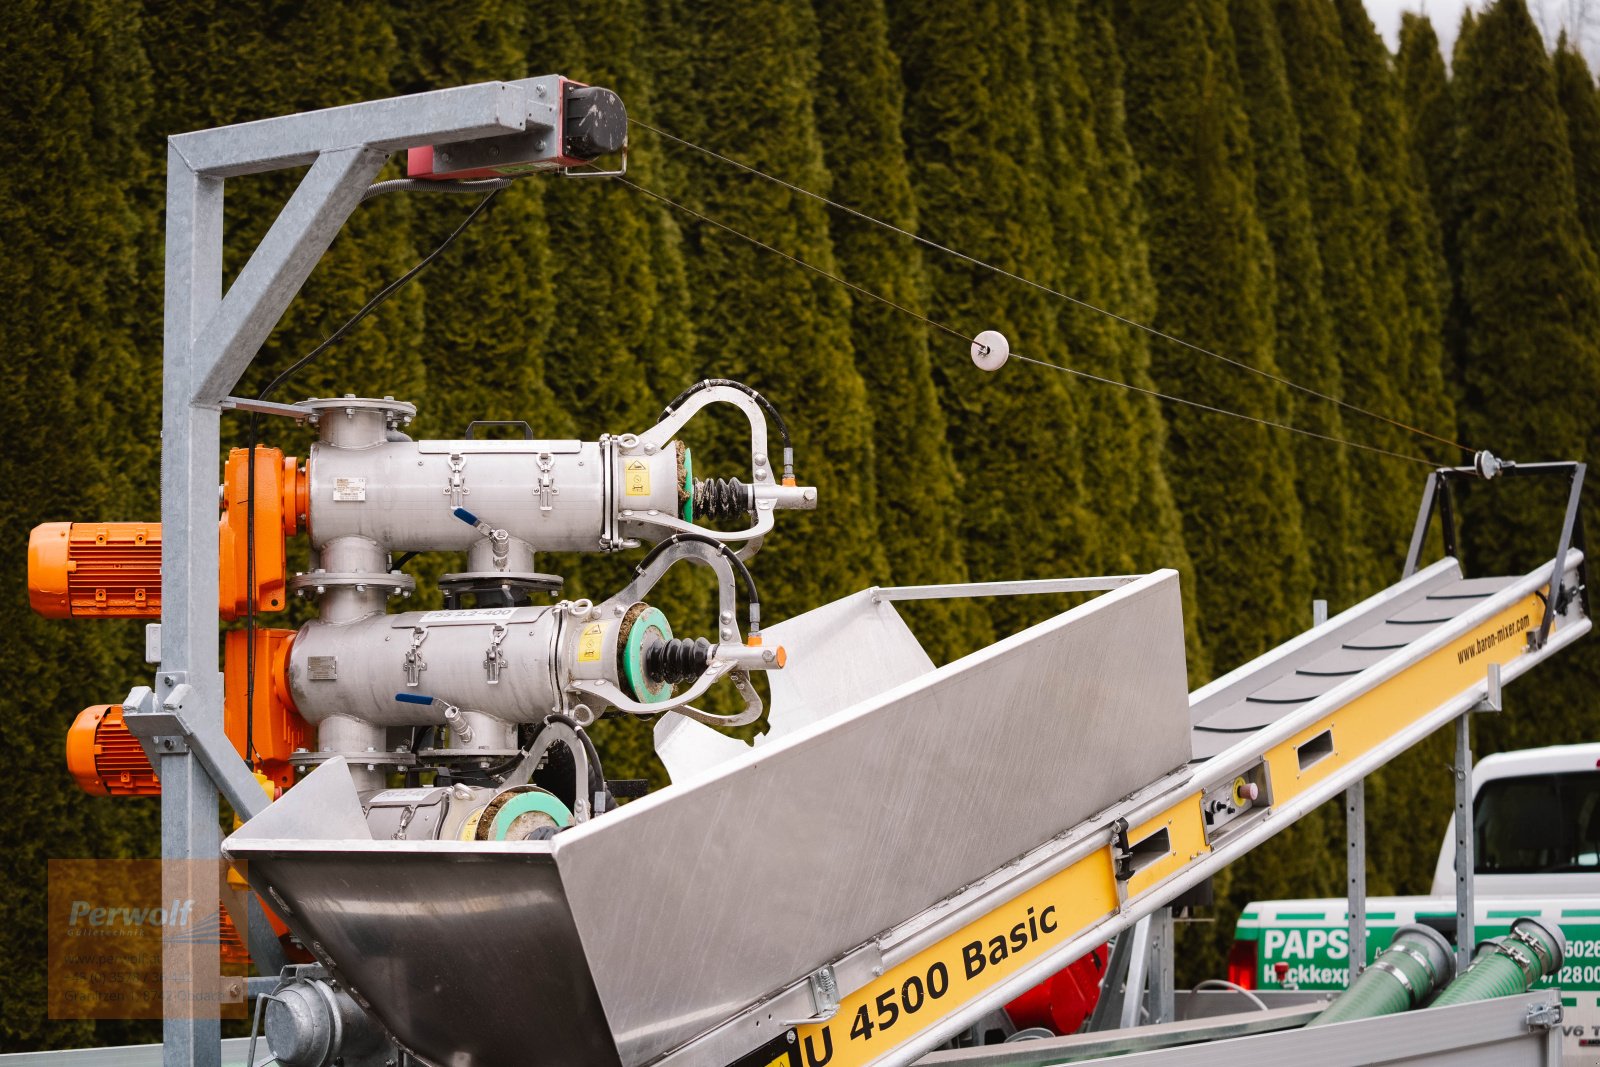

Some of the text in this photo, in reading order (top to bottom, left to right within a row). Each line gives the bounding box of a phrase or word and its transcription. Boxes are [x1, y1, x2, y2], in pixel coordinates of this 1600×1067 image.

[1457, 613, 1530, 665] www.baron-mixer.com
[1264, 929, 1370, 959] PAPS
[849, 961, 949, 1042] 4500
[962, 904, 1058, 981] Basic
[1562, 1025, 1584, 1037] V6
